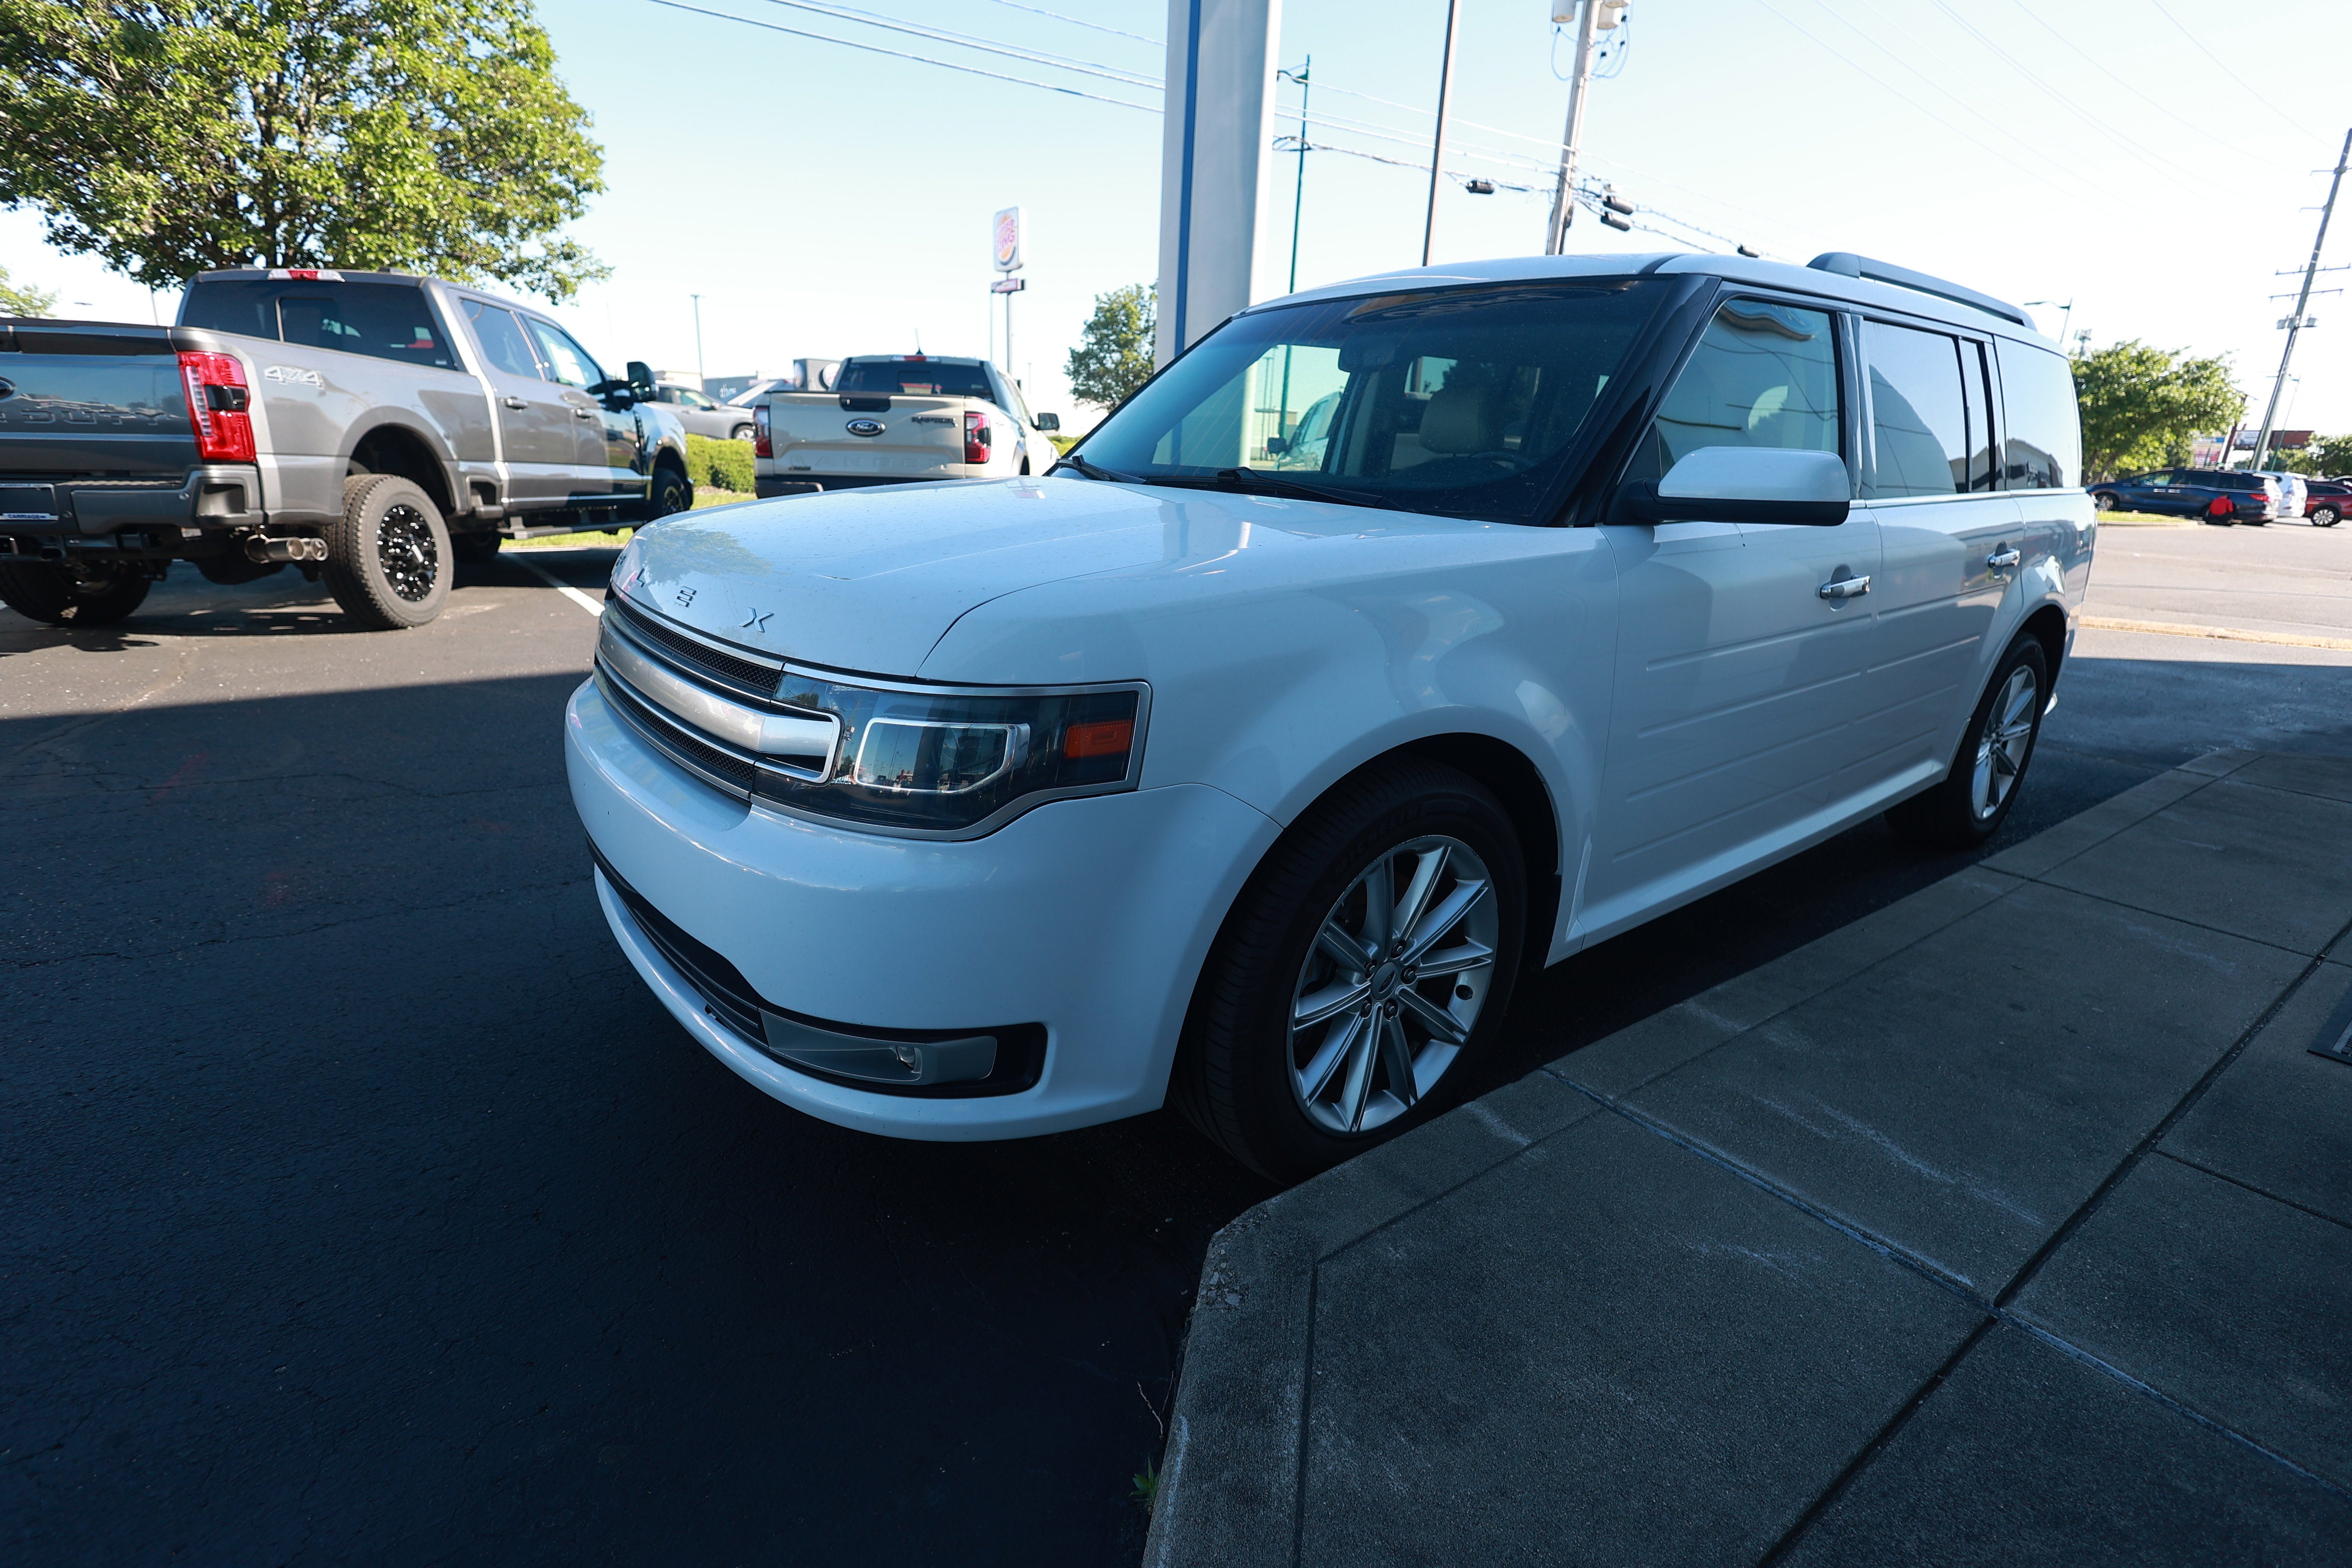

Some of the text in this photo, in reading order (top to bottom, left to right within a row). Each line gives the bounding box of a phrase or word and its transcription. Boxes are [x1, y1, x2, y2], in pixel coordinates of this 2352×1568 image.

[21, 409, 165, 426] DUTY
[790, 455, 946, 469] RANGER
[616, 555, 775, 633] FLEX
